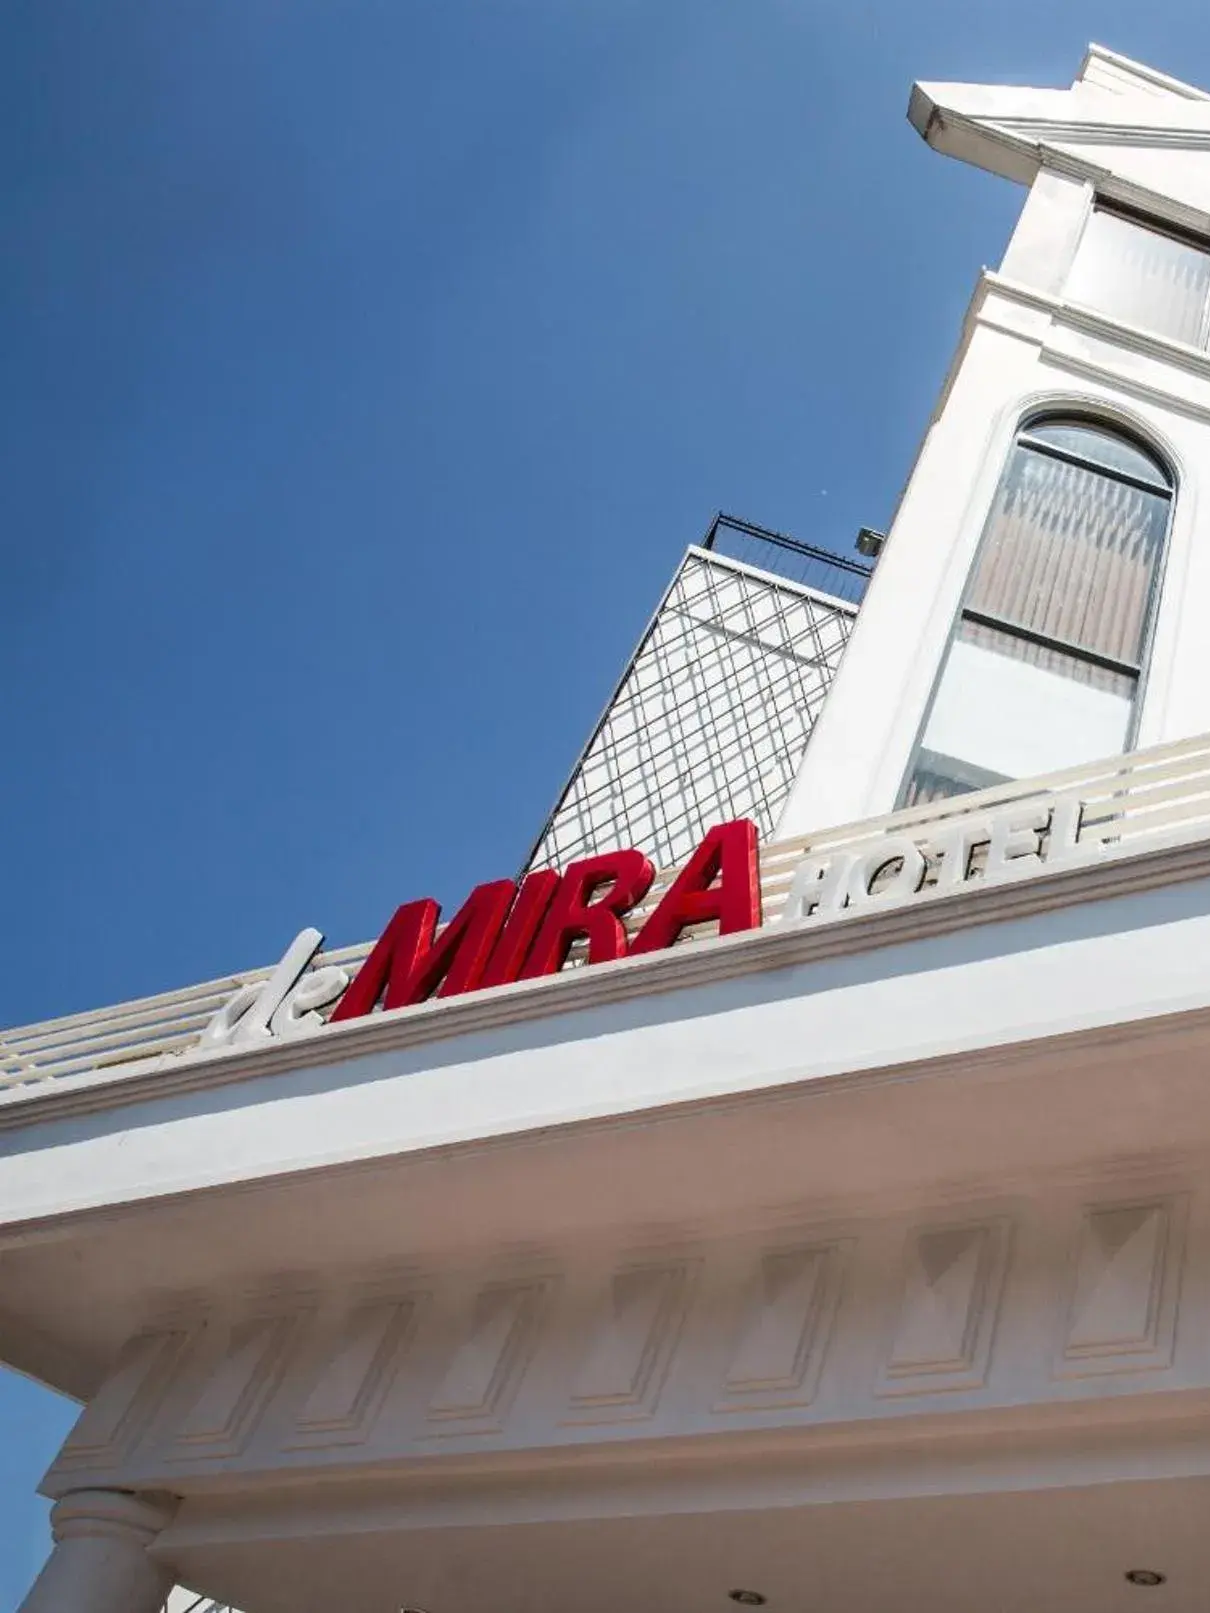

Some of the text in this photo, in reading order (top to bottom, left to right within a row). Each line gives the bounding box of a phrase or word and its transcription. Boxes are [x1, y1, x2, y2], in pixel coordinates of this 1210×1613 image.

[200, 794, 1104, 1046] de MIRA HOTEL
